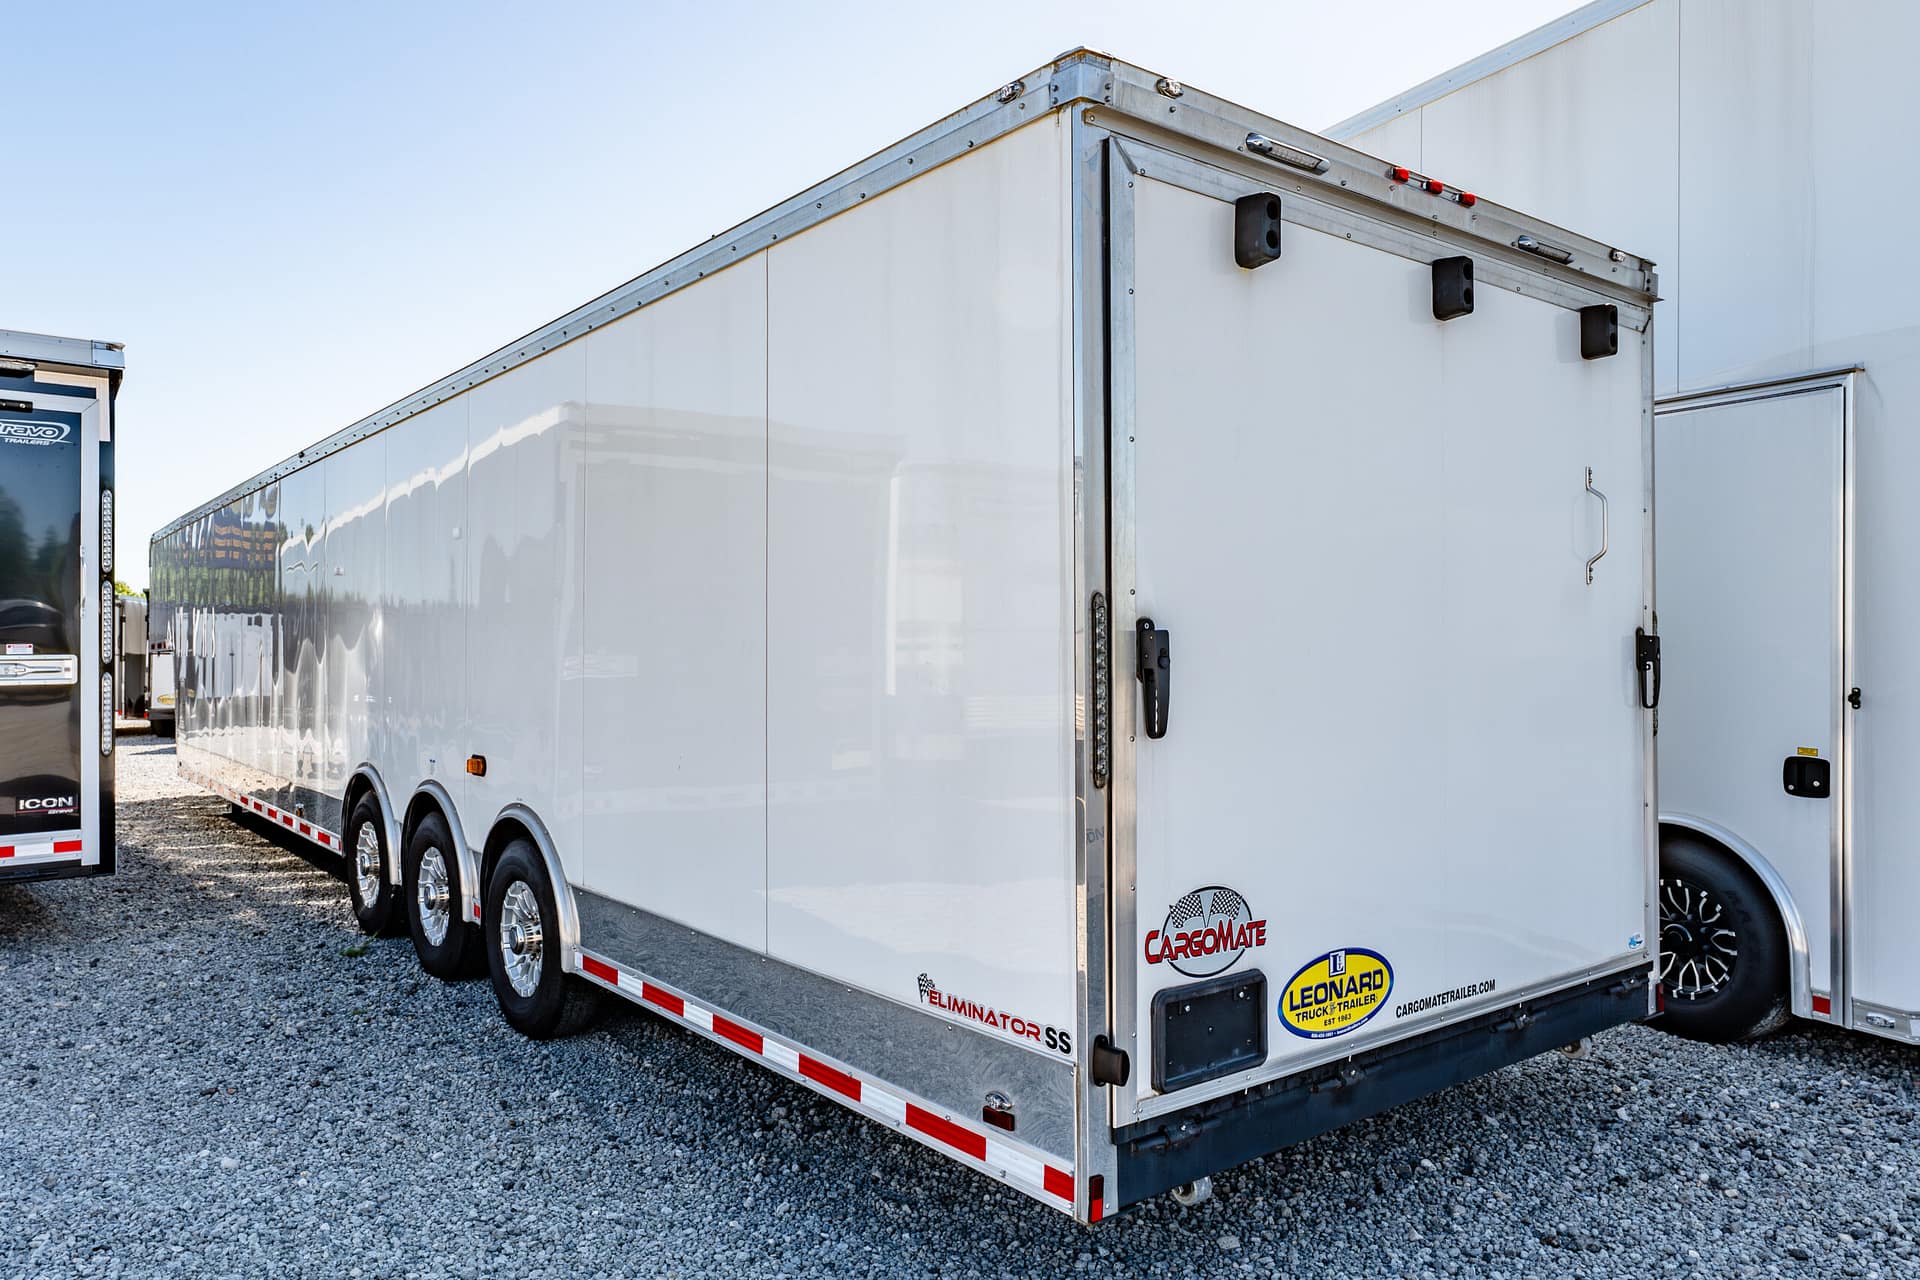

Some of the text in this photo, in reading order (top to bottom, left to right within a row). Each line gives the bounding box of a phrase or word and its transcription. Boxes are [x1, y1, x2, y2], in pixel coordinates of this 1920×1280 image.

[4, 437, 50, 446] TRAILERS
[19, 796, 74, 810] ICON
[1289, 968, 1384, 1012] LEONARD
[1395, 979, 1496, 1019] CARGOMATETRAILER.COM
[928, 989, 1072, 1055] ELIMINATOR SS
[1295, 1005, 1329, 1023] TRUCK
[1337, 993, 1377, 1012] TRAILER
[1323, 1017, 1336, 1027] EST
